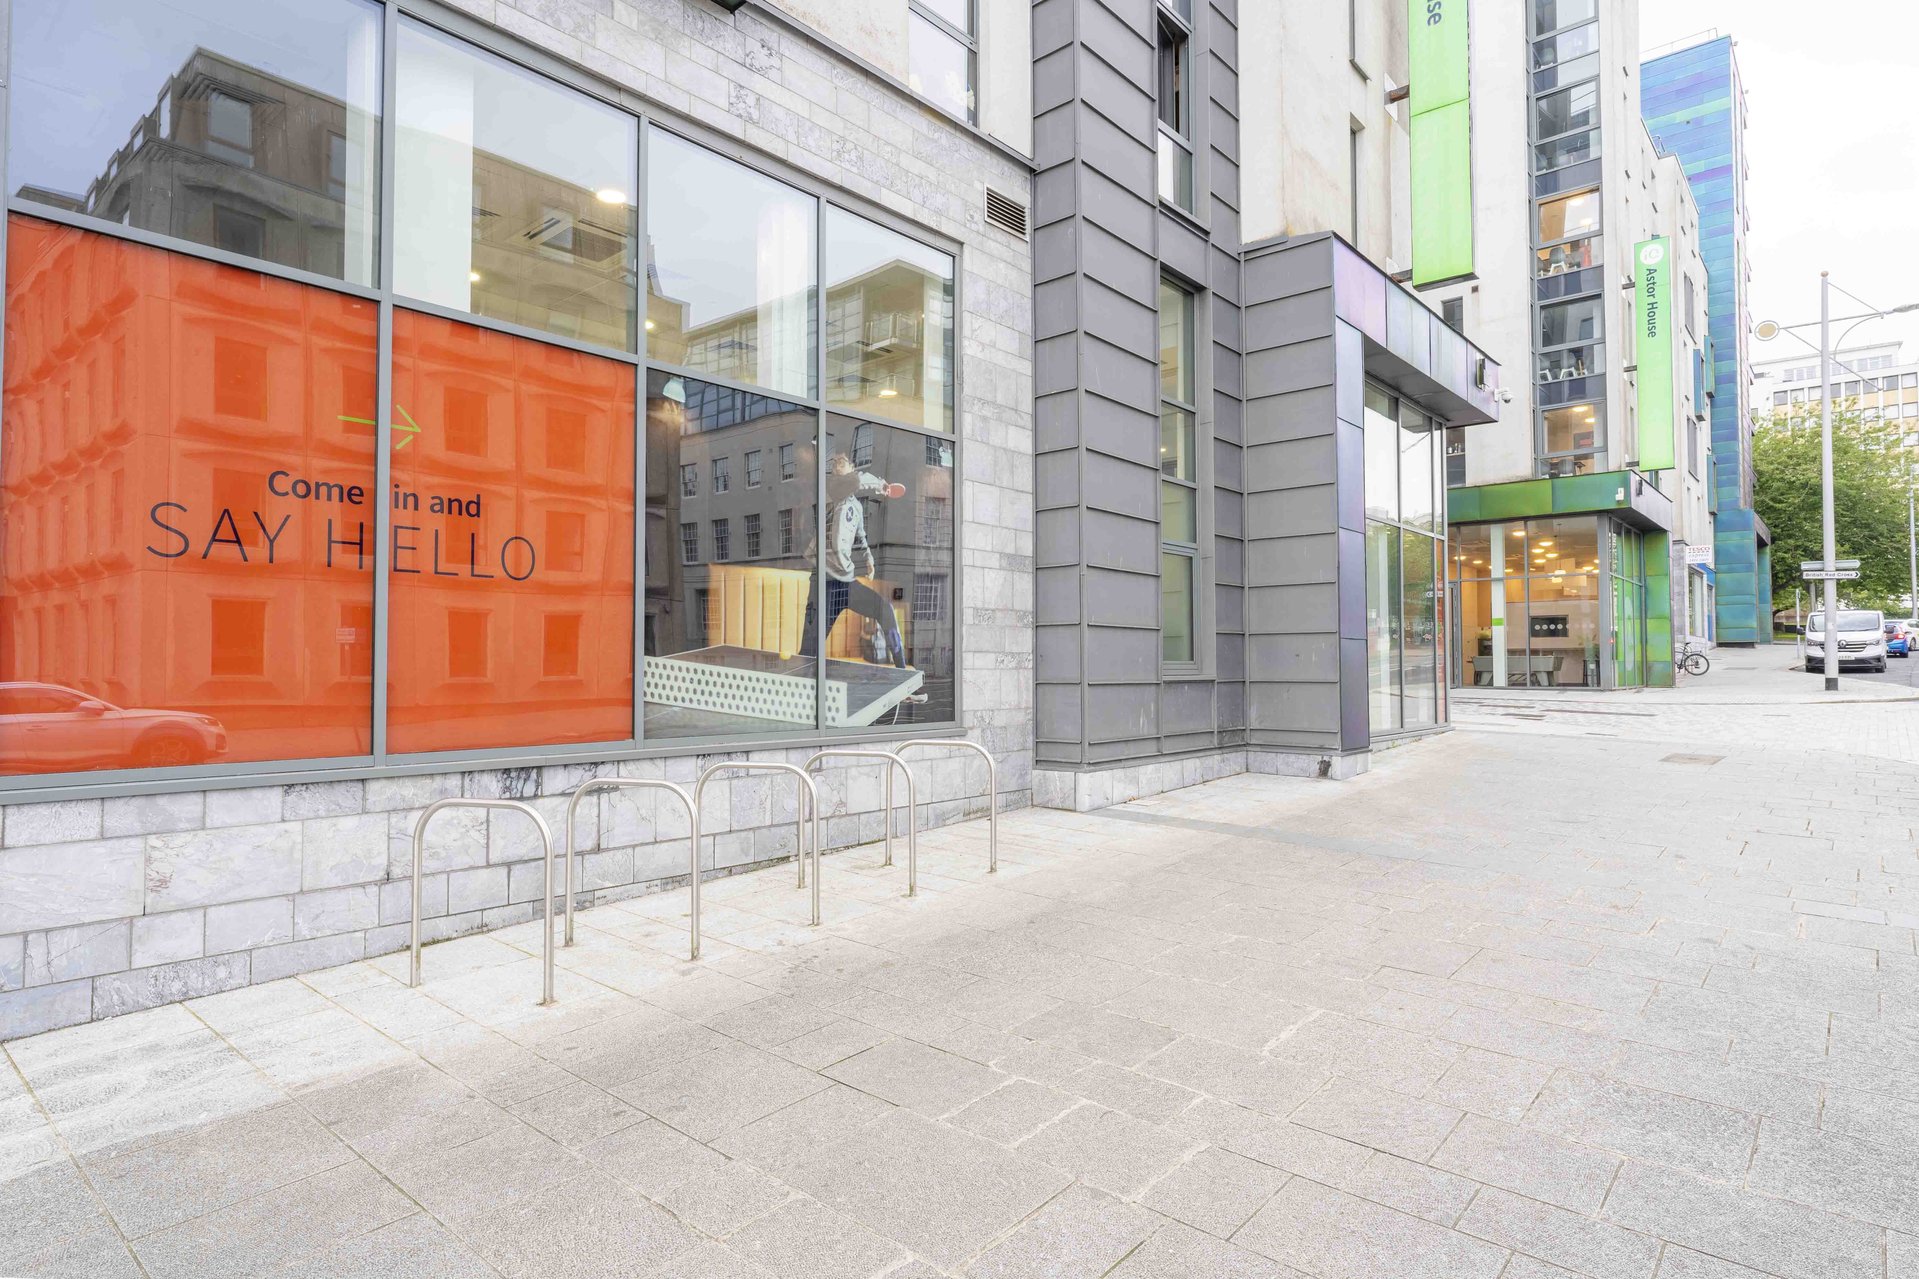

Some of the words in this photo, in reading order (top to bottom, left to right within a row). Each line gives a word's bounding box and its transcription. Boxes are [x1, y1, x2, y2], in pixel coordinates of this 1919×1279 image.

[1646, 268, 1657, 298] Astor
[1647, 302, 1658, 338] House
[268, 470, 364, 505] Come
[394, 483, 419, 512] in
[429, 494, 482, 518] and
[146, 501, 291, 565] SAY
[327, 518, 536, 582] HELLO
